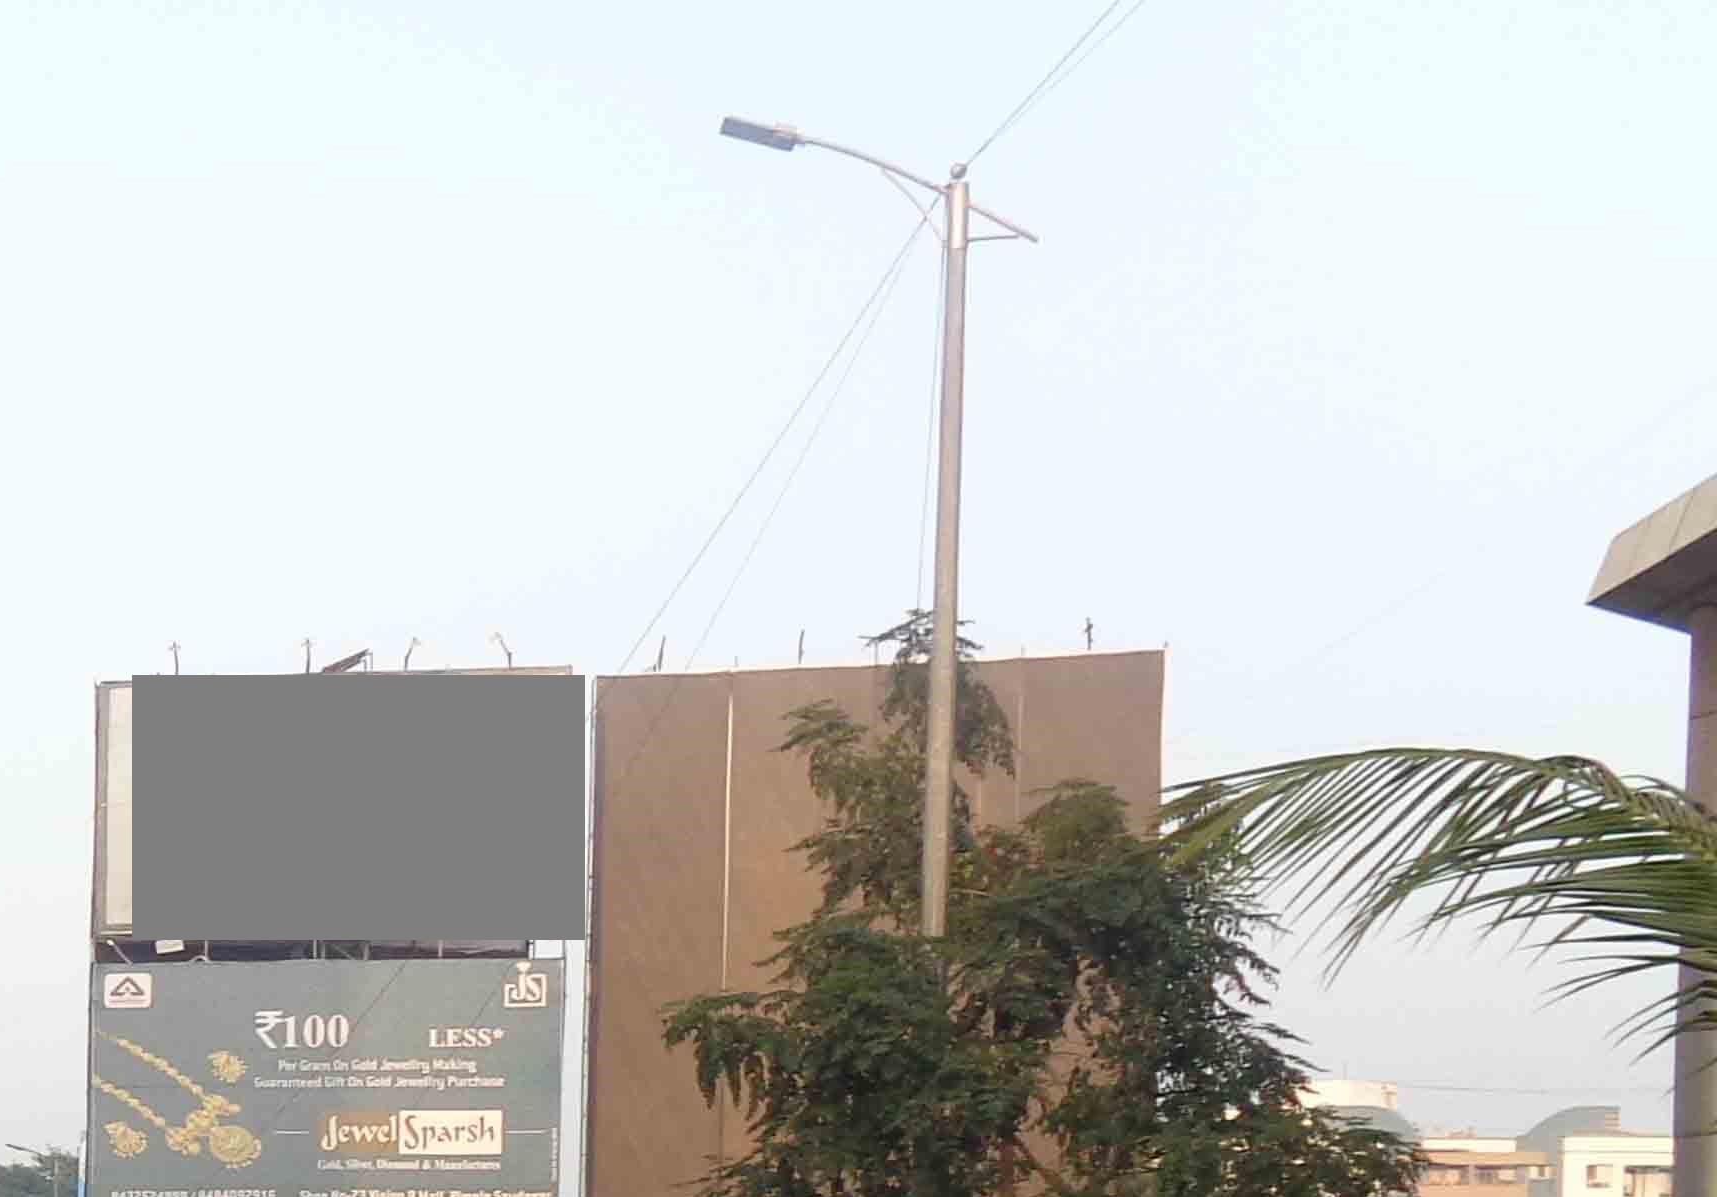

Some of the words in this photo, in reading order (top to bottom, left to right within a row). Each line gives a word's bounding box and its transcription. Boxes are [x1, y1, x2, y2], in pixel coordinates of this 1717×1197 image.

[254, 1010, 350, 1049] ₹100
[278, 1060, 296, 1072] Per
[299, 1060, 331, 1072] Gram
[351, 1059, 378, 1072] Gold
[432, 1059, 477, 1073] Making
[253, 1076, 322, 1088] Guaranteed
[366, 1076, 392, 1088] Gold
[448, 1076, 506, 1088] Purchase
[321, 1115, 397, 1151] Jewel
[403, 1115, 495, 1150] Sparsh
